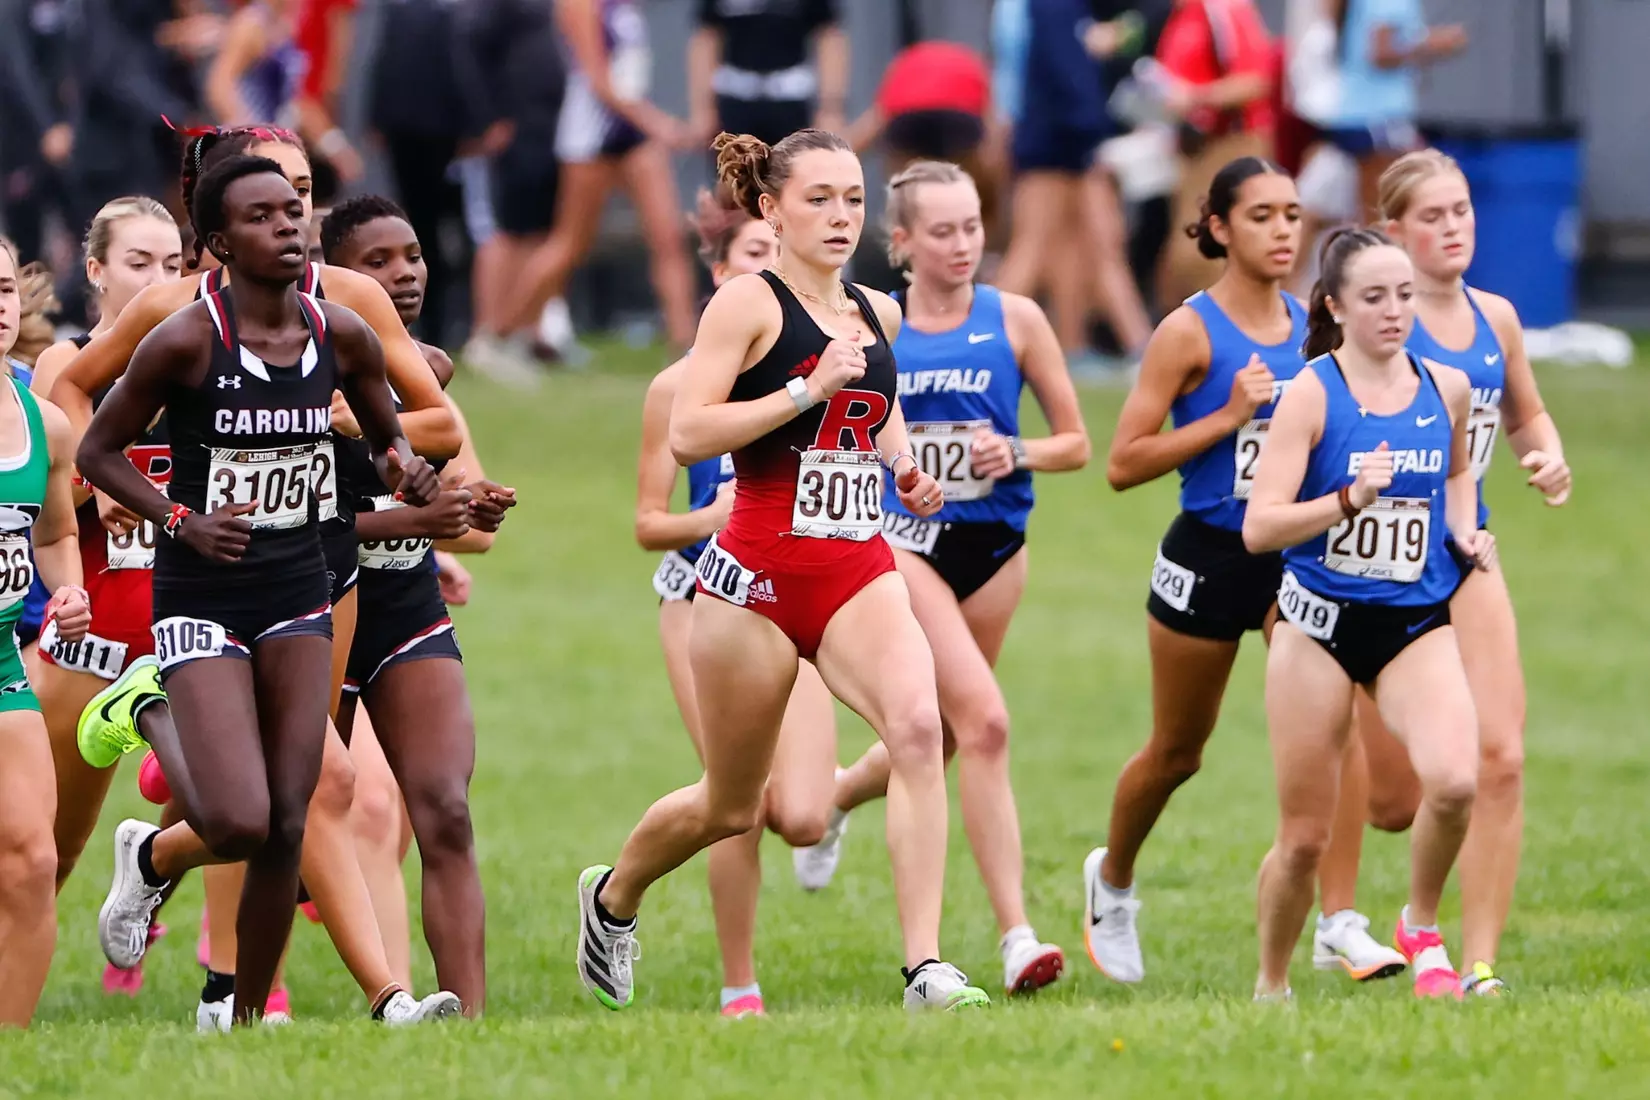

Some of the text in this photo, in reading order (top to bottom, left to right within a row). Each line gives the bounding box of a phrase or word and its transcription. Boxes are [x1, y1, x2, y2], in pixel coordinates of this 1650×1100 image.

[248, 451, 278, 462] LEHIGH
[1347, 449, 1443, 476] BFALO
[210, 464, 308, 517] 3105
[800, 470, 880, 522] 3010
[1331, 516, 1424, 562] 2019
[157, 621, 213, 662] 3105
